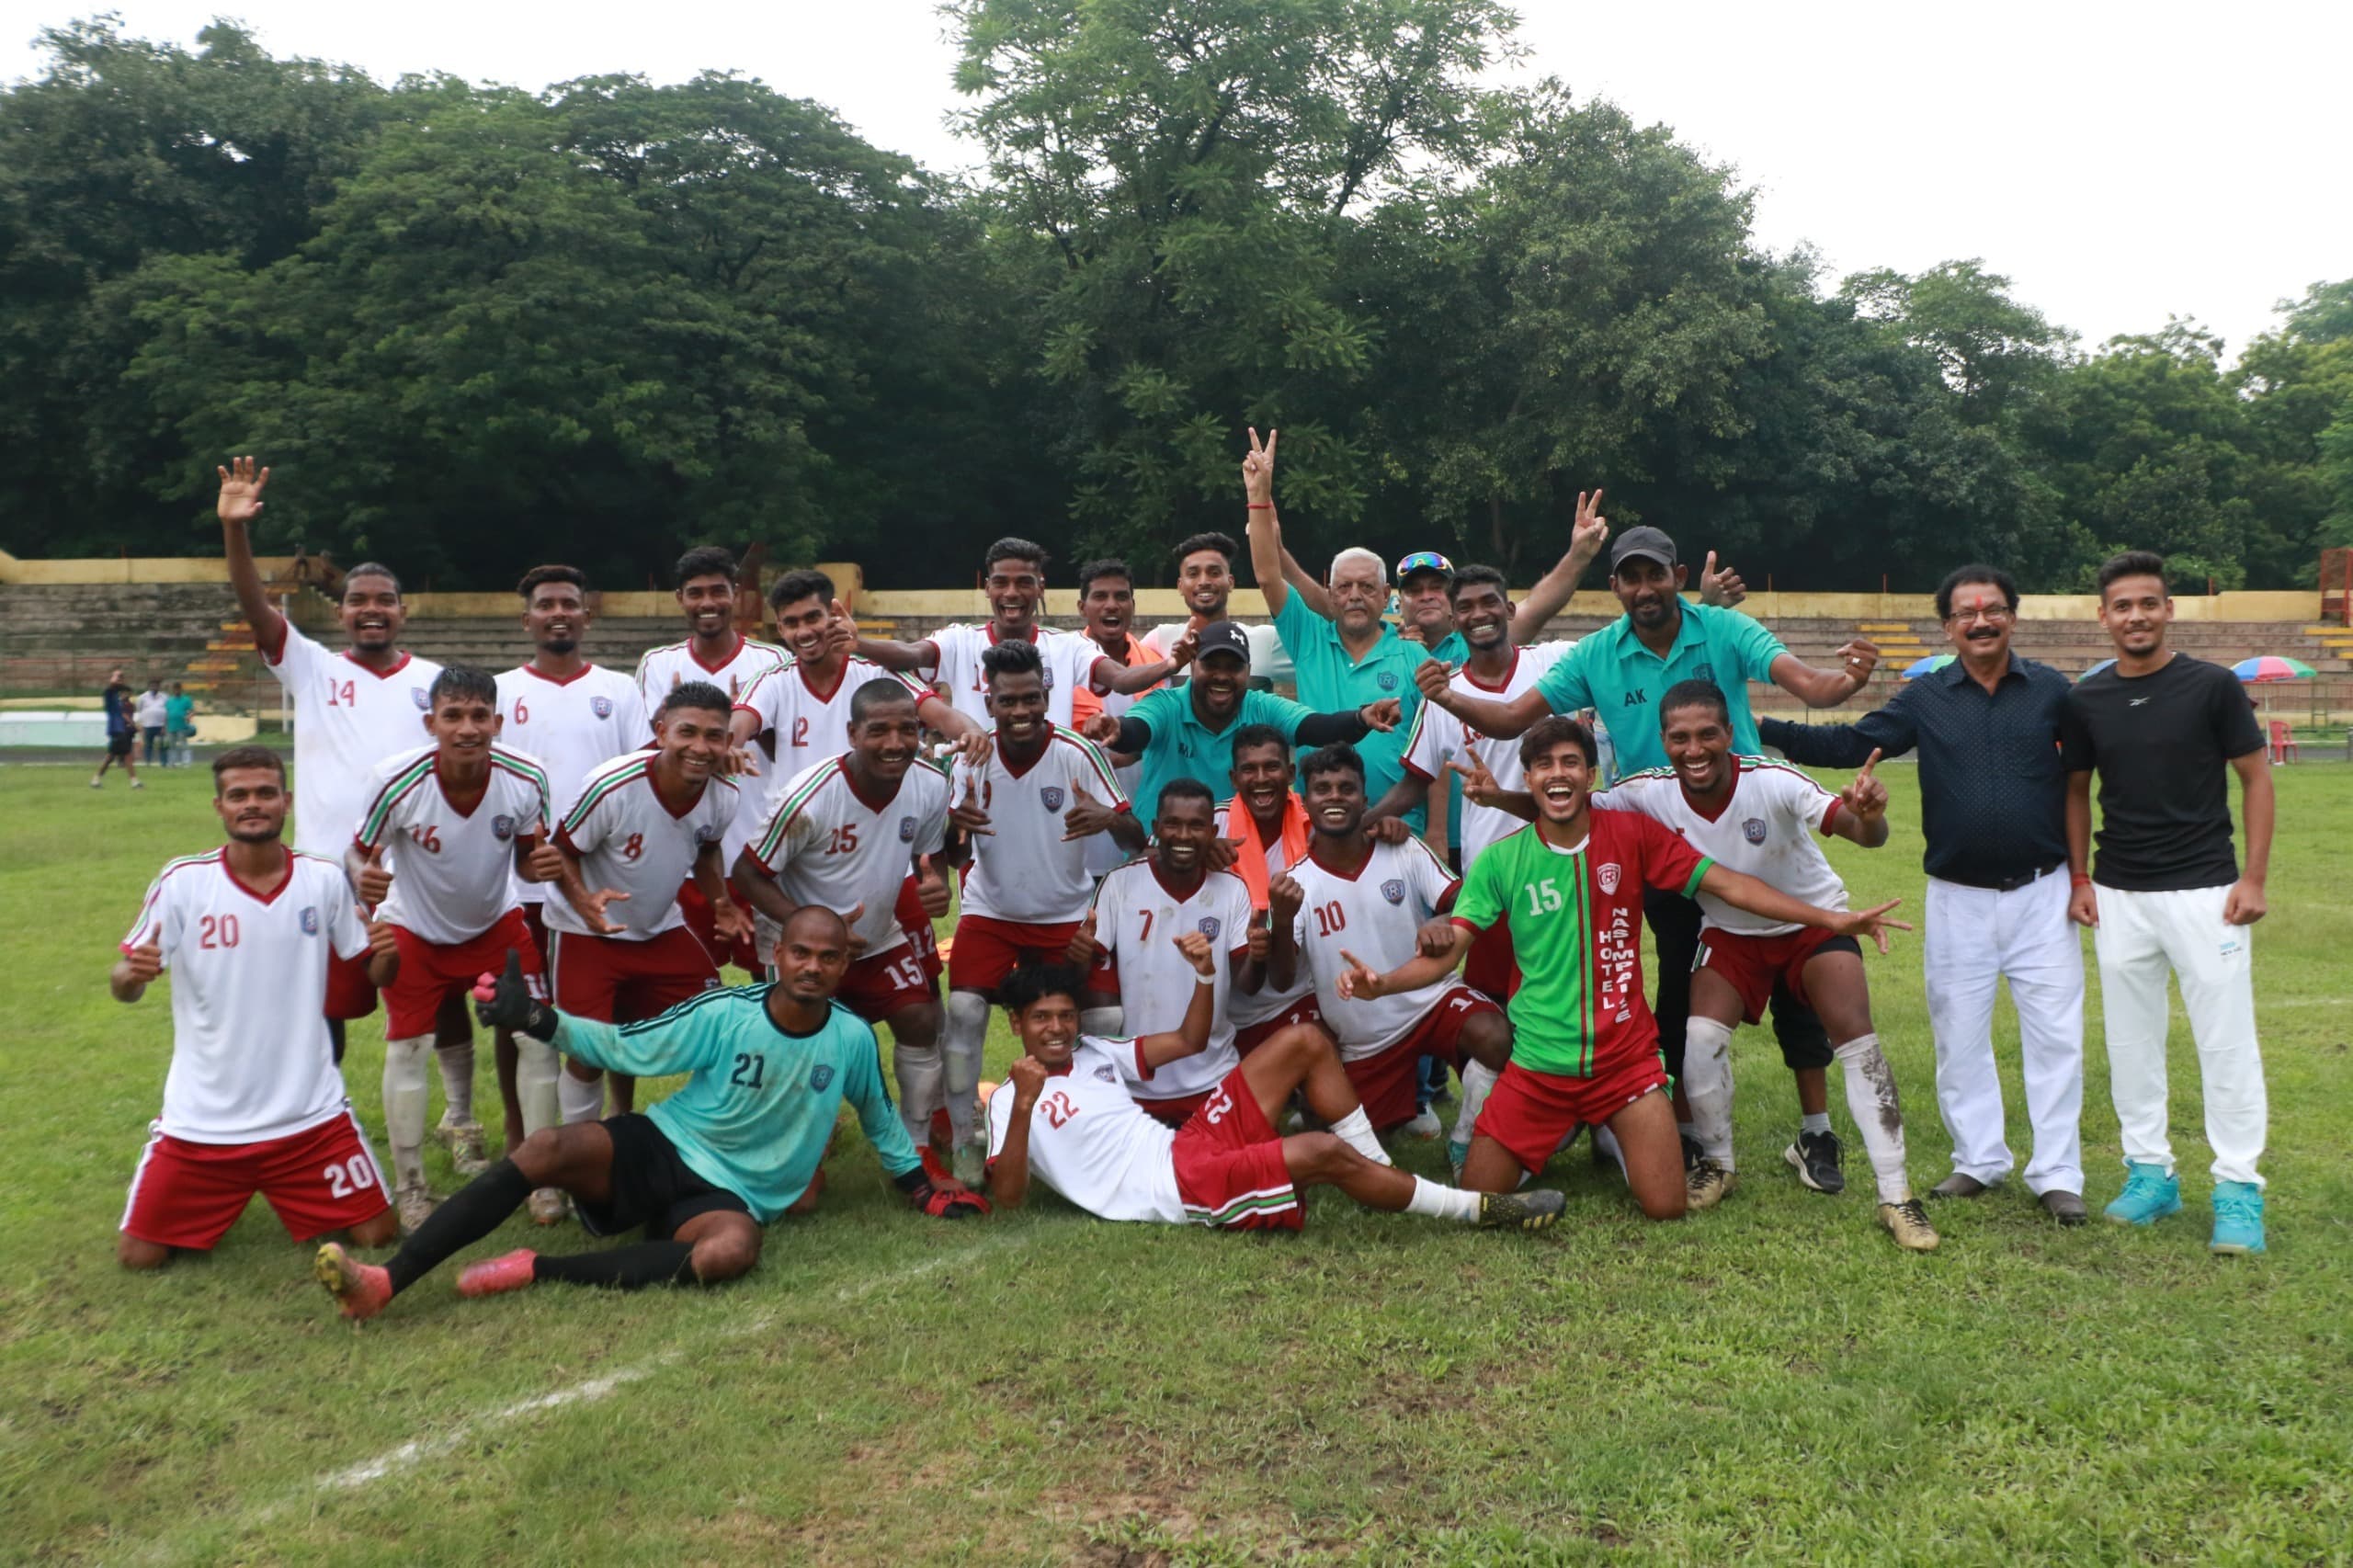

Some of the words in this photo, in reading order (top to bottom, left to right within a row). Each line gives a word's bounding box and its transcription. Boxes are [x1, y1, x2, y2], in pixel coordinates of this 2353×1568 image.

[327, 676, 354, 707] 14
[972, 664, 989, 694] 1
[513, 696, 529, 725] 6
[1624, 687, 1647, 707] AK
[623, 832, 643, 861] 8
[824, 824, 858, 856] 15
[1525, 879, 1562, 916] 15
[199, 914, 238, 949] 20
[1139, 909, 1154, 942] 7
[1313, 900, 1346, 937] 10
[883, 956, 924, 991] 15
[1598, 930, 1615, 1009] HOTEL
[731, 1052, 764, 1088] 21
[1040, 1091, 1079, 1131] 22
[324, 1154, 375, 1199] 20
